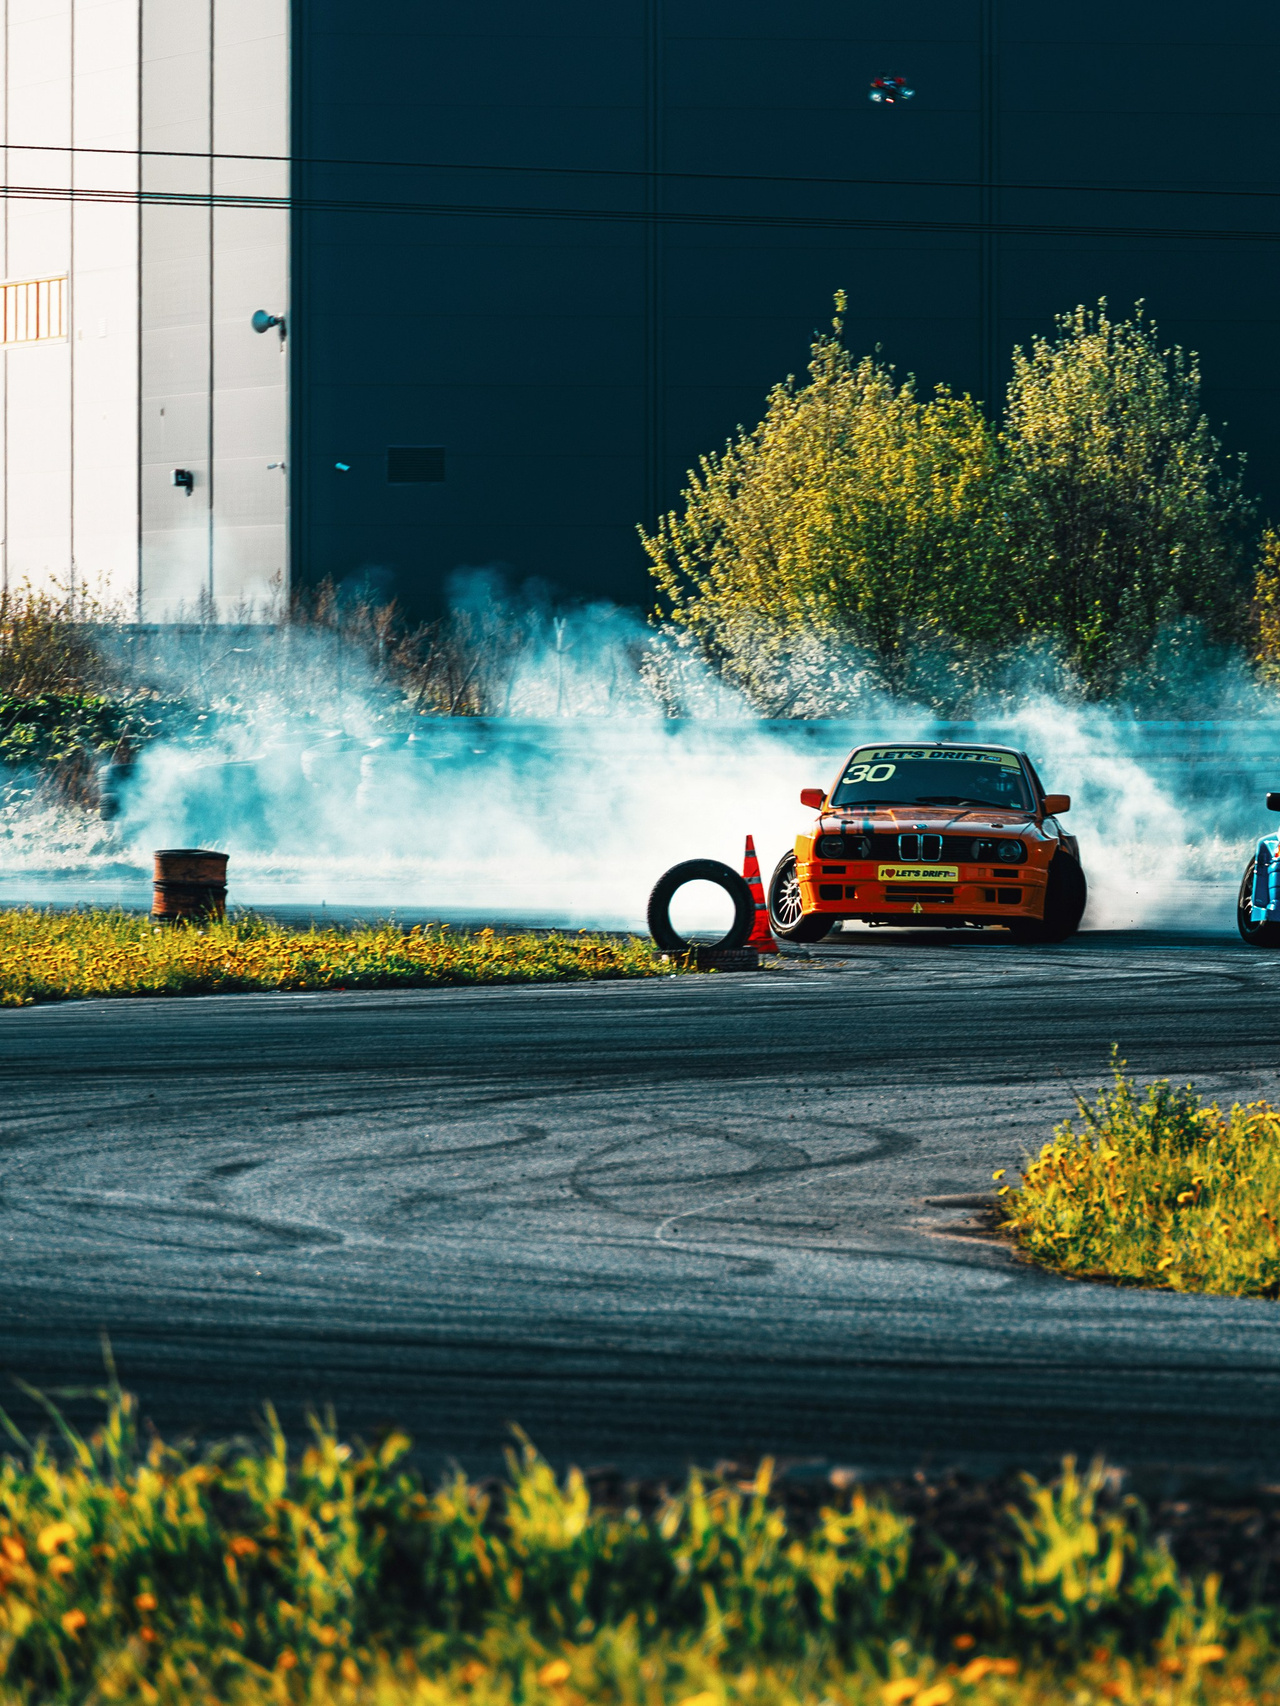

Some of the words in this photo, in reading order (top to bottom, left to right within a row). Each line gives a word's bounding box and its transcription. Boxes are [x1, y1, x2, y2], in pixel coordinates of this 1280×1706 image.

[871, 751, 926, 761] LET'S
[929, 751, 988, 761] DRIFT
[842, 764, 896, 784] 30
[922, 870, 950, 878] DRIFT
